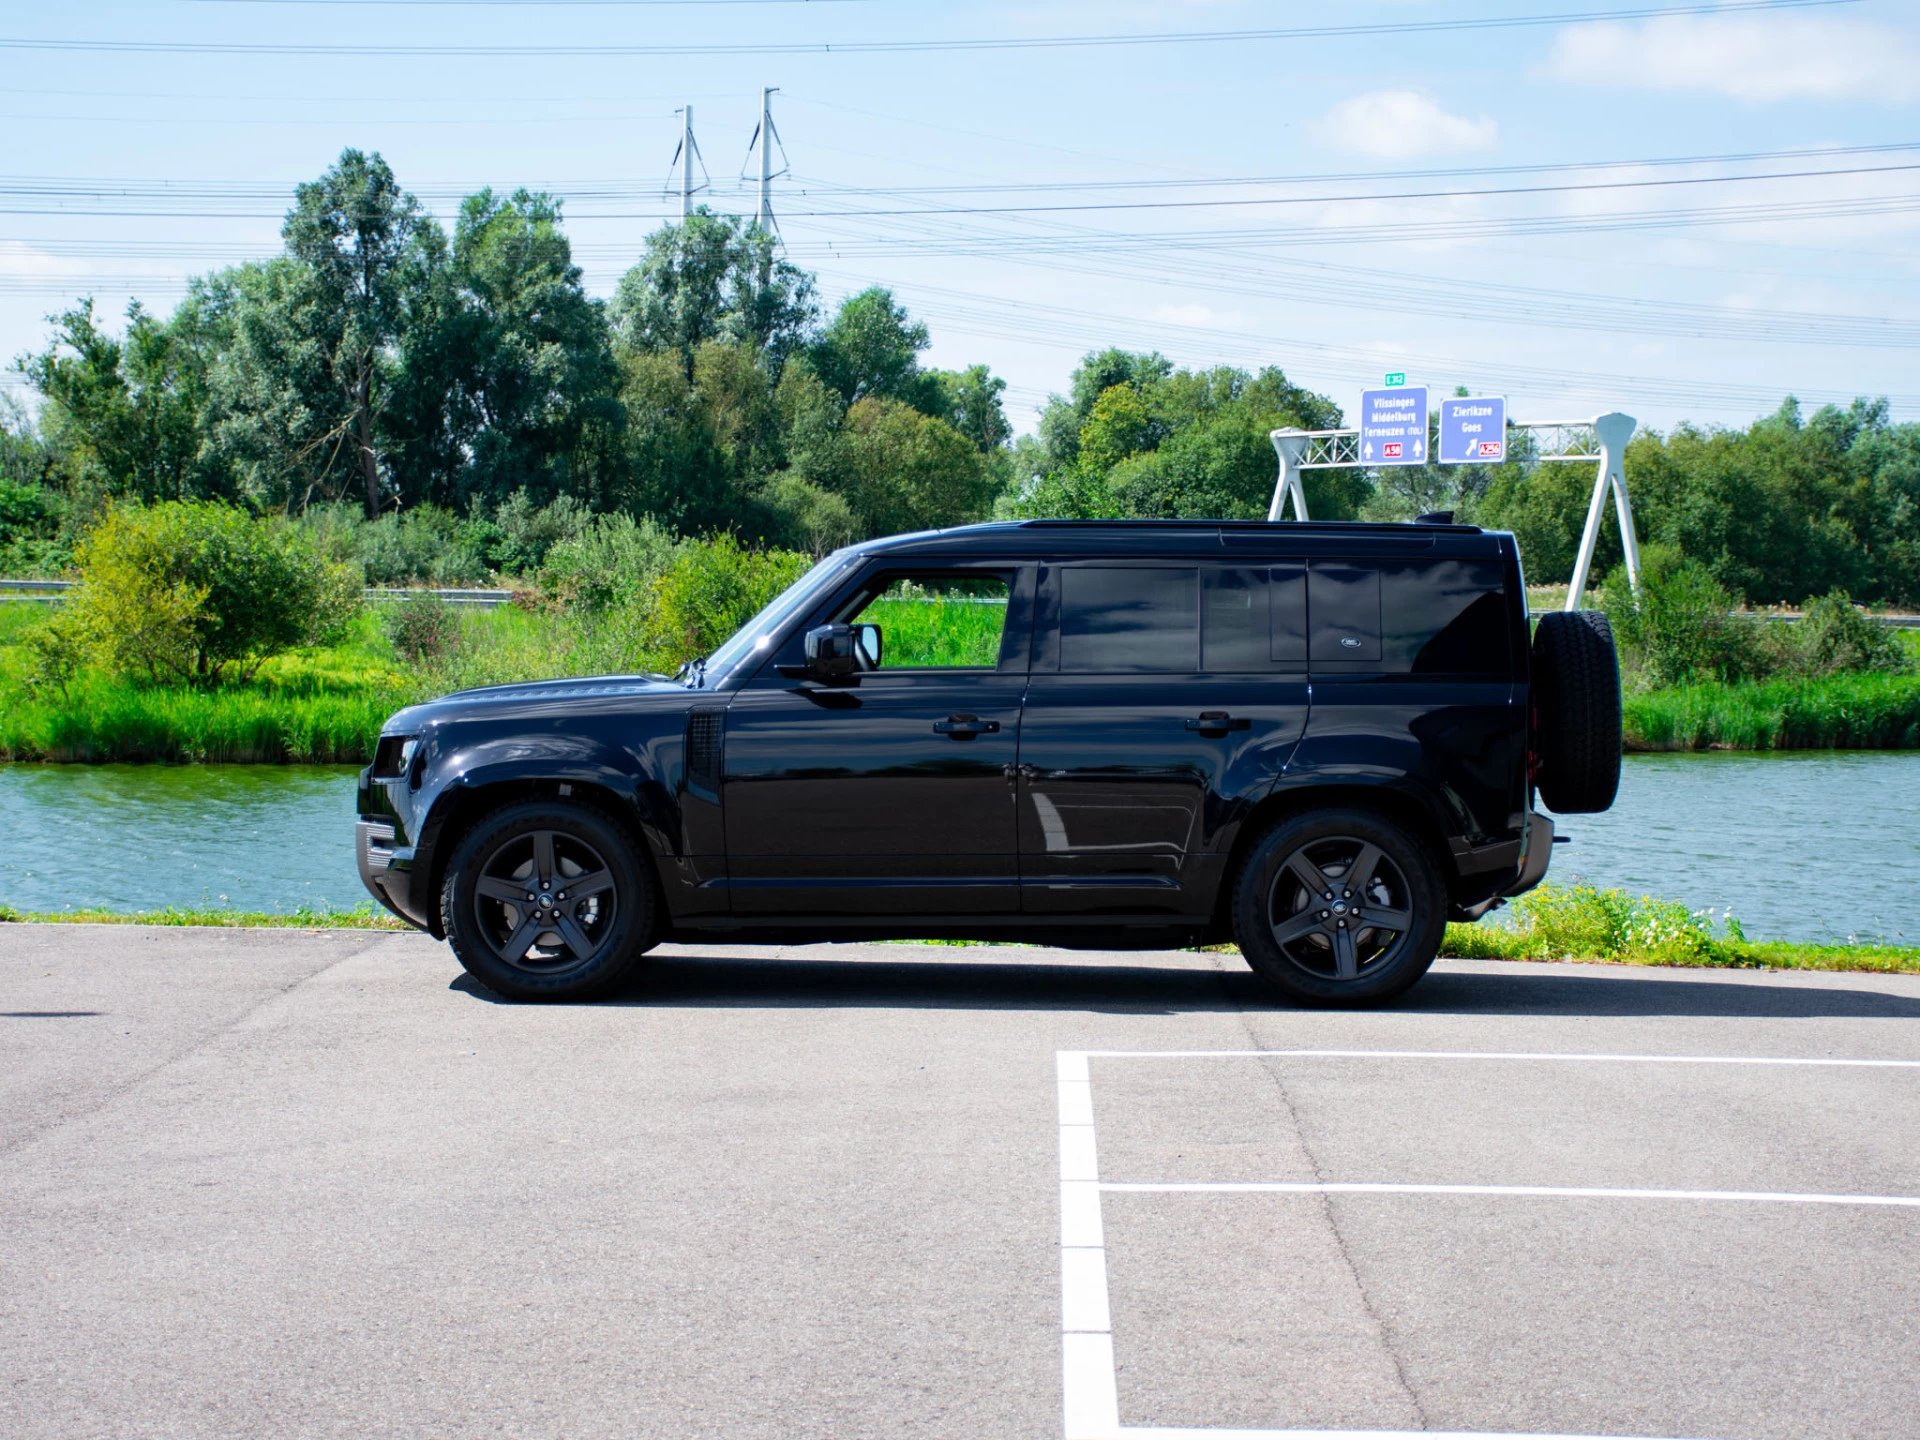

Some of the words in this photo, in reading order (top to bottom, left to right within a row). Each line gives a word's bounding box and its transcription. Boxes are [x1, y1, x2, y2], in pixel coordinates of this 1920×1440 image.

[1373, 398, 1415, 409] Vlissingen
[1372, 411, 1416, 423] Middelburg
[1453, 406, 1492, 417] Zierikzee
[1364, 427, 1404, 437] Terneuzen
[1462, 423, 1482, 432] Goes
